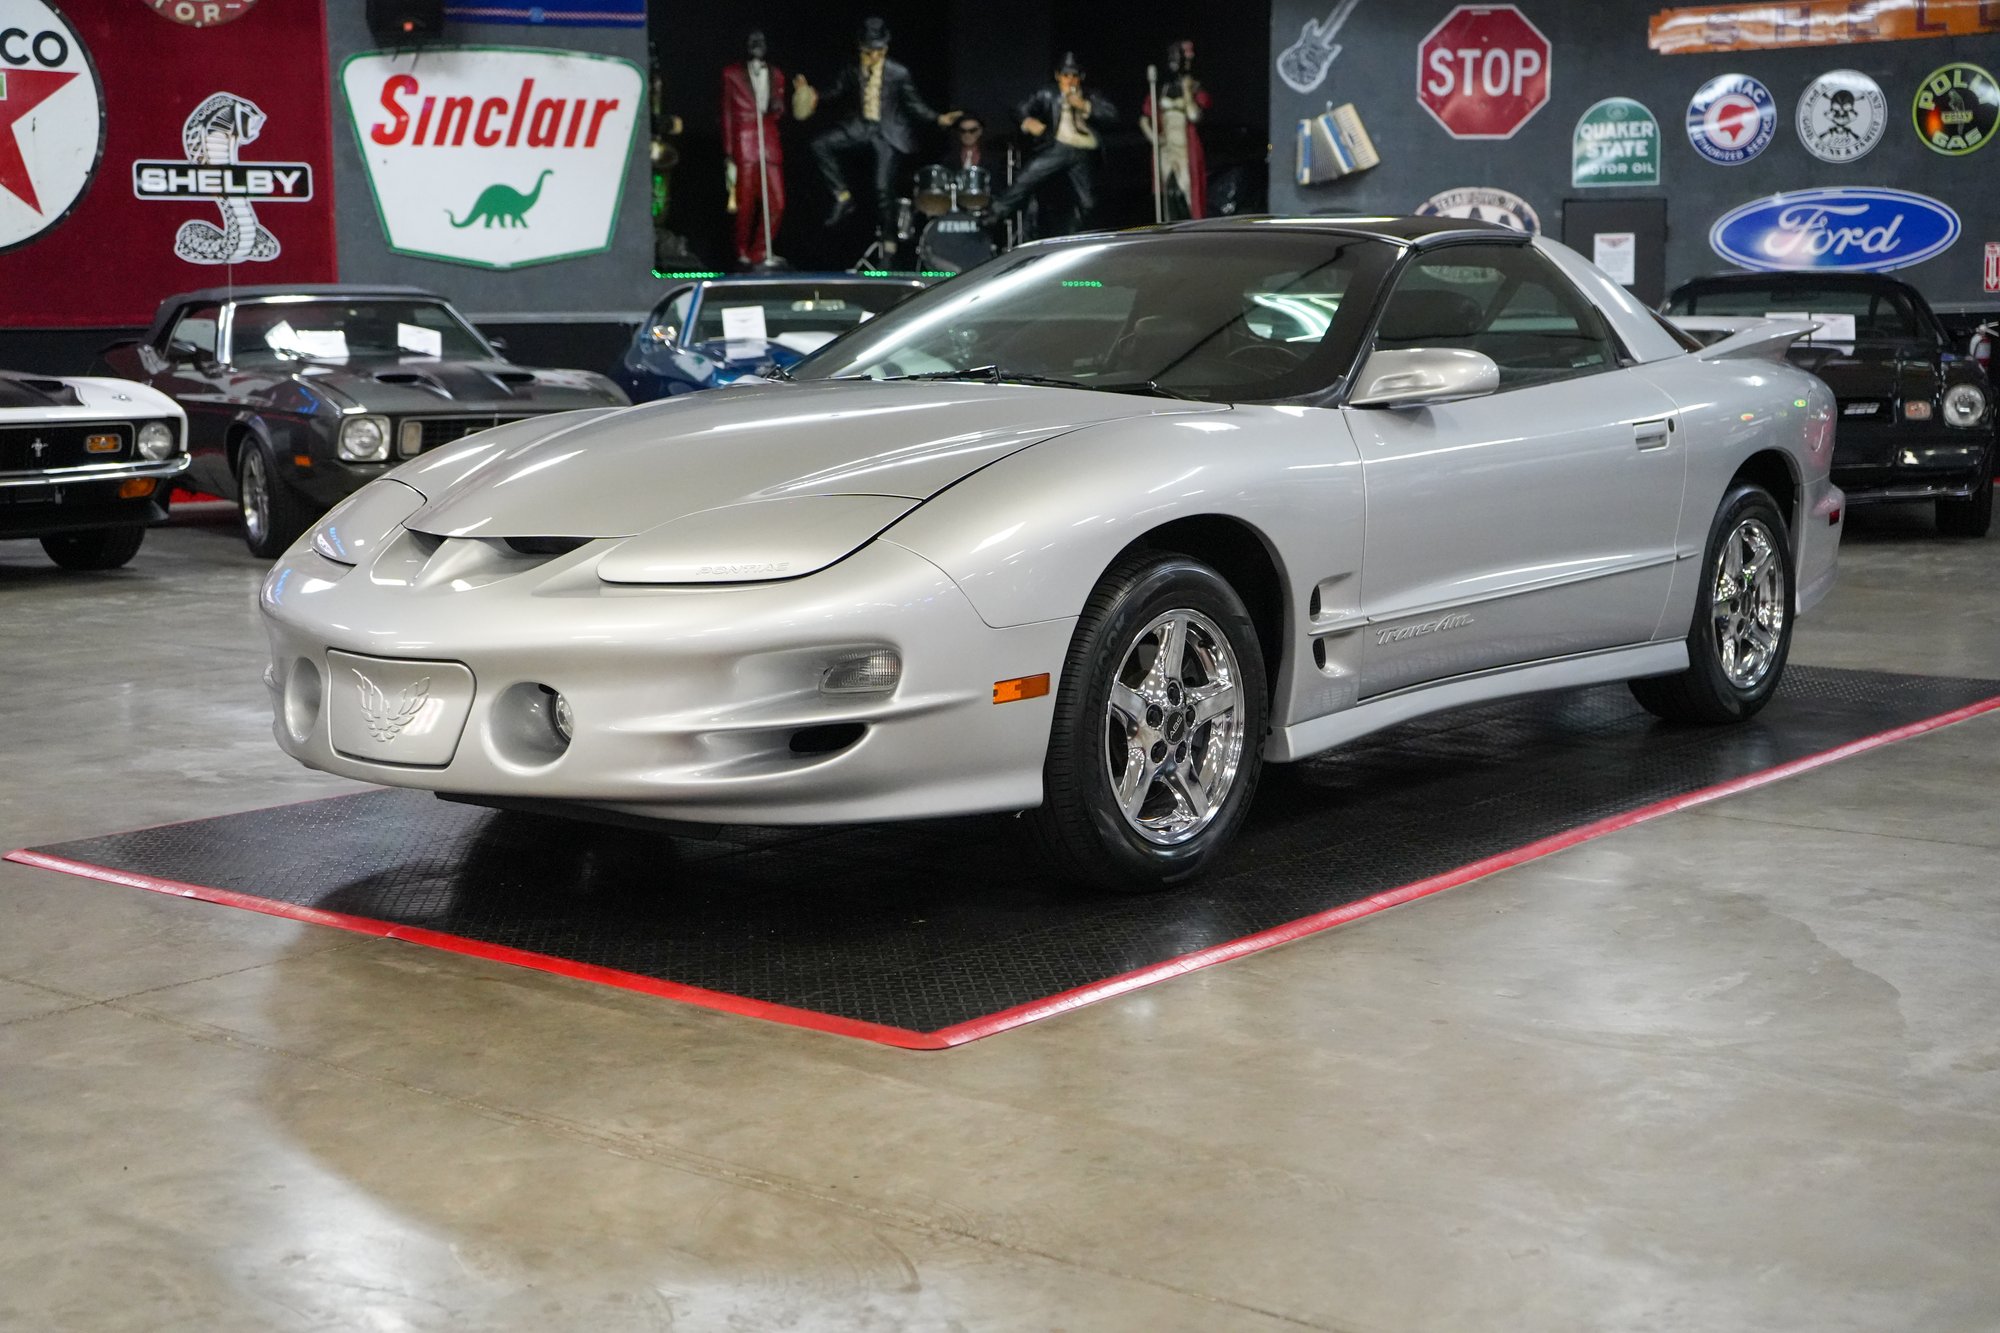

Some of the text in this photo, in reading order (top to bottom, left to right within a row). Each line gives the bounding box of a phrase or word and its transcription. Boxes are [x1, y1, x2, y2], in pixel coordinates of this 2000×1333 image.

[1428, 48, 1542, 97] STOP
[1691, 79, 1766, 111] PTIAC
[370, 73, 620, 148] Sinclair
[1580, 121, 1655, 140] QUAKER
[1931, 126, 1983, 150] GAS
[1586, 139, 1649, 159] STATE
[1688, 127, 1744, 161] UTHORIZED
[1631, 161, 1655, 174] OIL
[141, 168, 301, 194] SHELBY
[1762, 204, 1904, 257] Ford
[696, 561, 790, 576] PONTIAC
